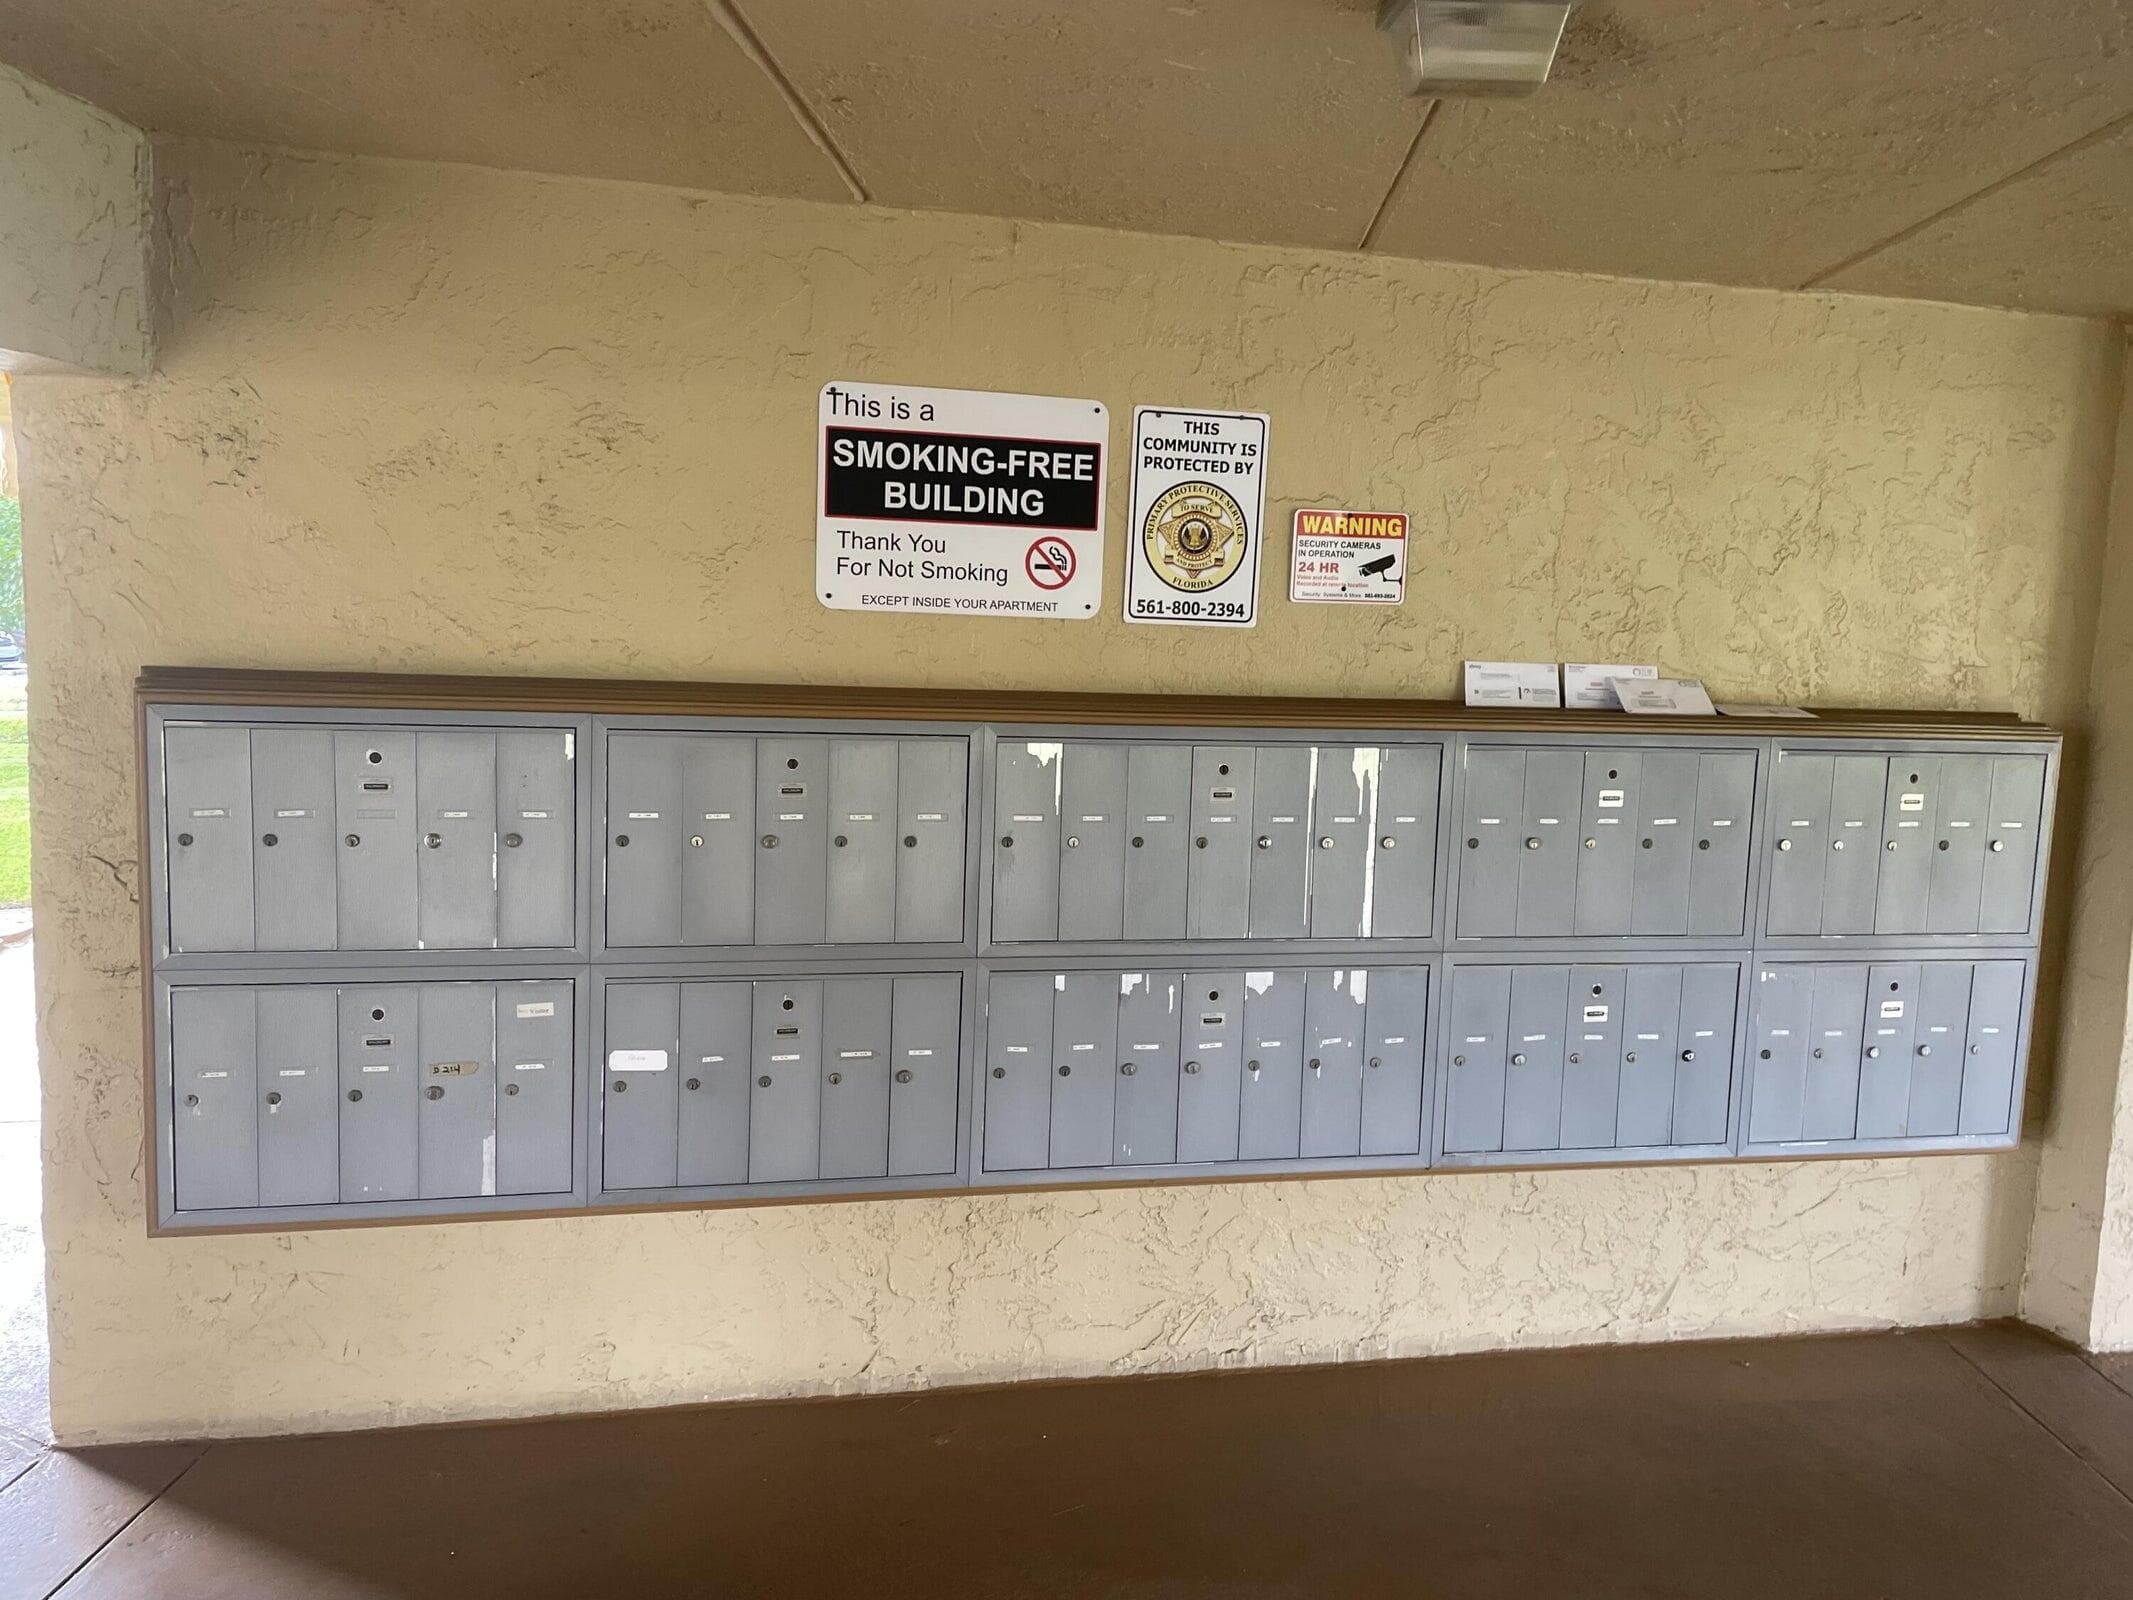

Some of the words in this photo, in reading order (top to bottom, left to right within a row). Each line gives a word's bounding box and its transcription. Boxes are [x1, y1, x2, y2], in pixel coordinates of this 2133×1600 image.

[826, 390, 881, 417] This
[891, 396, 910, 420] is
[919, 404, 935, 421] a
[1183, 421, 1220, 436] THIS
[1143, 436, 1237, 455] COMMUNITY
[1241, 443, 1257, 456] IS
[833, 438, 1094, 481] SMOKING-FREE
[1143, 457, 1230, 474] PROTECTED
[1234, 460, 1254, 475] BY
[884, 481, 1044, 516] BUILDING
[1147, 496, 1169, 540] PRIMARY
[1168, 485, 1226, 503] PROTECTIVE
[1225, 499, 1244, 545] SERVICES
[1191, 503, 1213, 513] SERVE
[1302, 515, 1403, 537] WARNING
[837, 530, 901, 551] Thank
[908, 534, 946, 553] You
[1298, 539, 1339, 549] SECURITY
[1340, 541, 1381, 550] CAMERAS
[1298, 549, 1307, 557] IN
[1308, 550, 1355, 558] OPERATION
[837, 557, 872, 576] For
[878, 558, 914, 578] Not
[921, 560, 1008, 586] Smoking
[1188, 559, 1213, 568] PROTECT
[1298, 561, 1315, 573] 24
[1319, 562, 1340, 573] HR
[1172, 576, 1214, 589] FLORIDA
[861, 594, 908, 607] EXCEPT
[912, 597, 951, 609] INSIDE
[953, 598, 988, 610] YOUR
[989, 600, 1058, 612] APARTMENT
[1136, 599, 1245, 618] 561-800-2394
